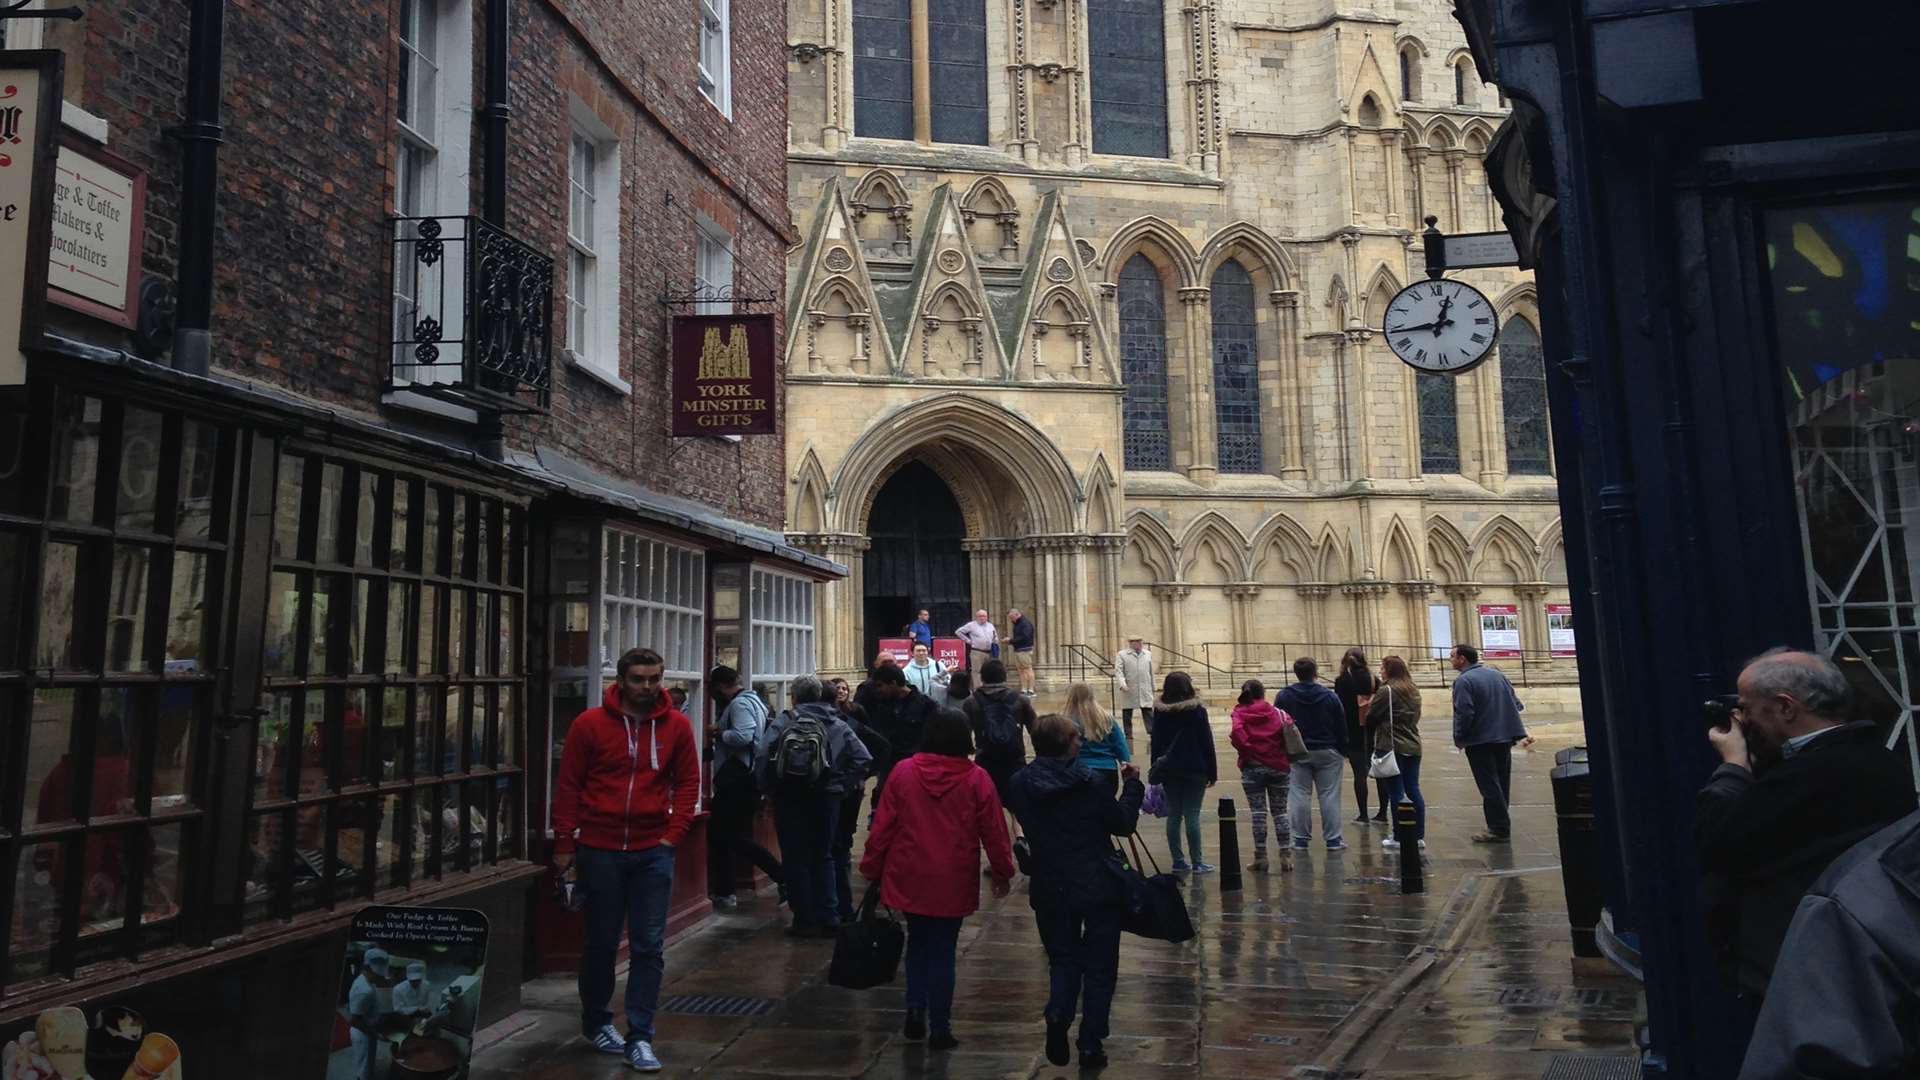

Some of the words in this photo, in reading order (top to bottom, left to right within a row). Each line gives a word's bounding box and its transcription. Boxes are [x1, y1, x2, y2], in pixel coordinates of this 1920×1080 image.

[56, 183, 70, 201] ge
[73, 186, 83, 206] &
[87, 191, 121, 222] Toffee
[94, 222, 104, 241] &
[697, 384, 752, 397] YORK
[682, 399, 767, 412] MINSTER
[697, 414, 752, 427] GIFTS
[939, 658, 960, 667] Only
[403, 913, 425, 921] Fudge
[438, 914, 459, 922] Toffee
[365, 921, 384, 929] Made
[425, 923, 449, 931] Cream
[366, 931, 394, 939] Cooked
[405, 933, 426, 942] Open
[427, 933, 455, 942] Copper
